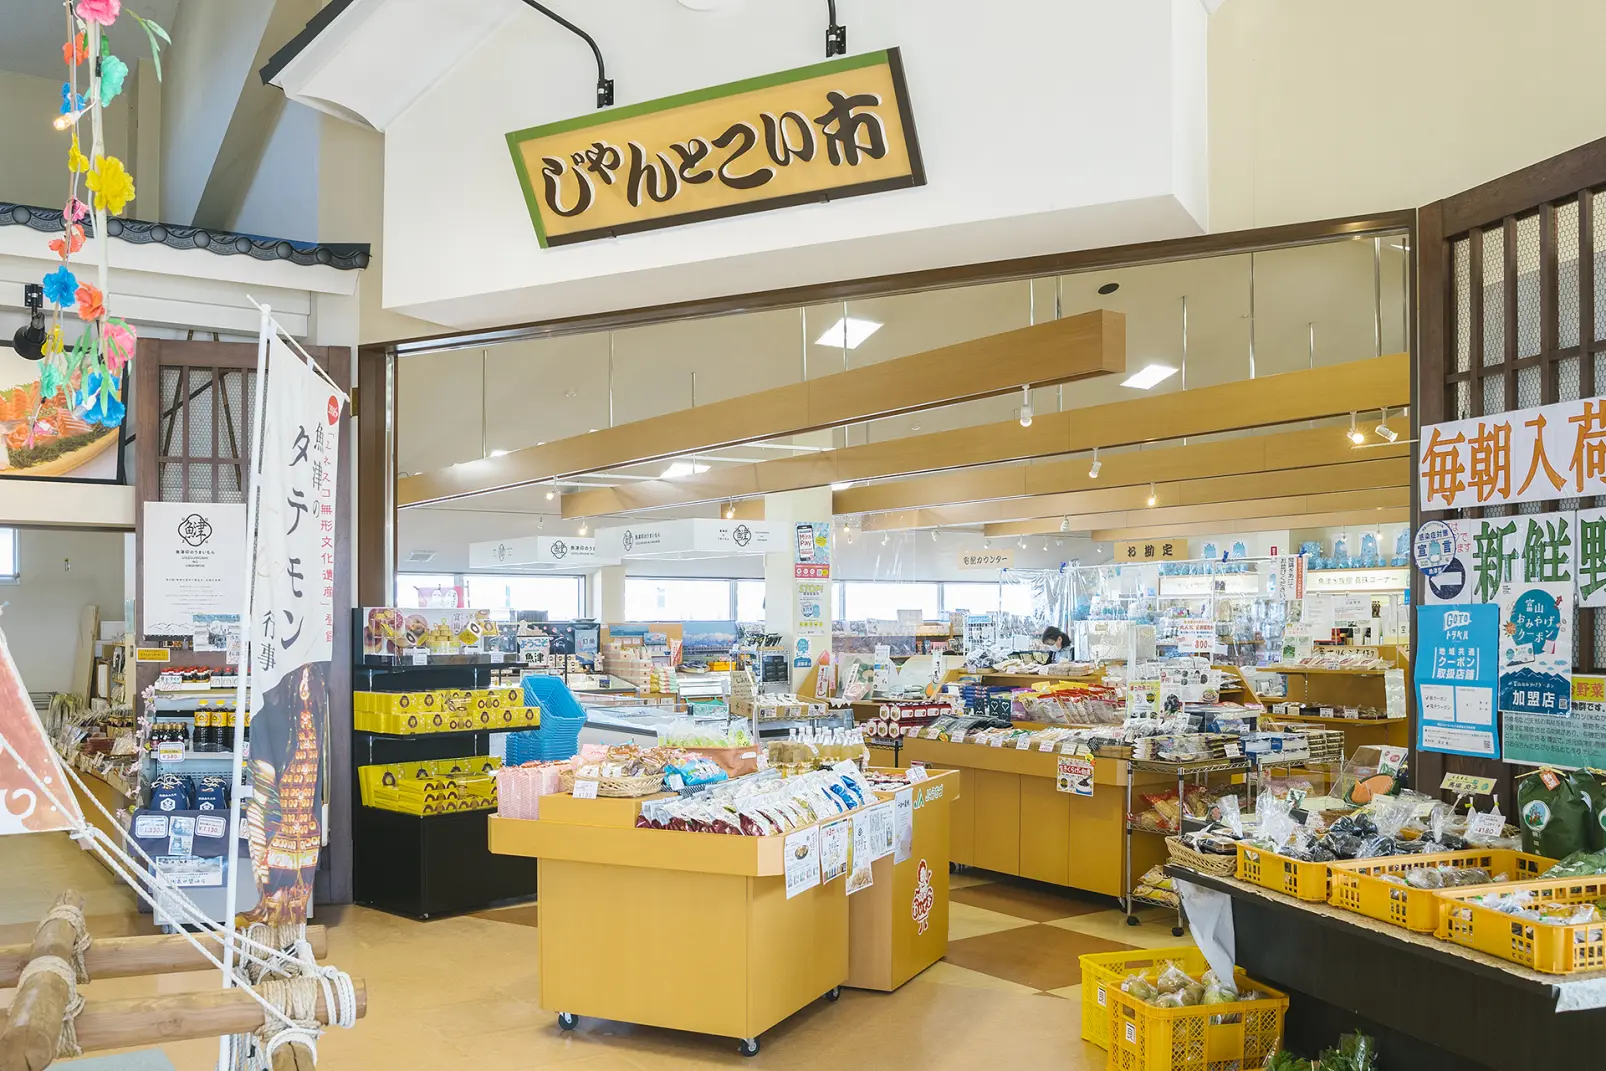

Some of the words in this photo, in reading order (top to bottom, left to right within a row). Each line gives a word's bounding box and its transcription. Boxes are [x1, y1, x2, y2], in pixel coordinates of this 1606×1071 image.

[541, 90, 888, 217] じゃんとこい市
[1421, 399, 1606, 506] 毎朝入荷
[280, 425, 311, 649] タテモン
[1127, 543, 1174, 558] お勘定
[963, 556, 1008, 565] 宅配カウンター
[1525, 599, 1544, 613] 富山
[1517, 614, 1555, 628] おみやげ
[258, 610, 277, 672] 行事
[1446, 631, 1469, 640] トラベル
[1518, 629, 1554, 643] クーポン
[520, 638, 548, 649] ようこそ
[524, 652, 545, 663] 魚津
[1438, 647, 1475, 656] 地域共通
[1438, 657, 1475, 667] クーポン
[1437, 669, 1475, 680] 取扱店舗
[1512, 690, 1555, 708] 加盟店
